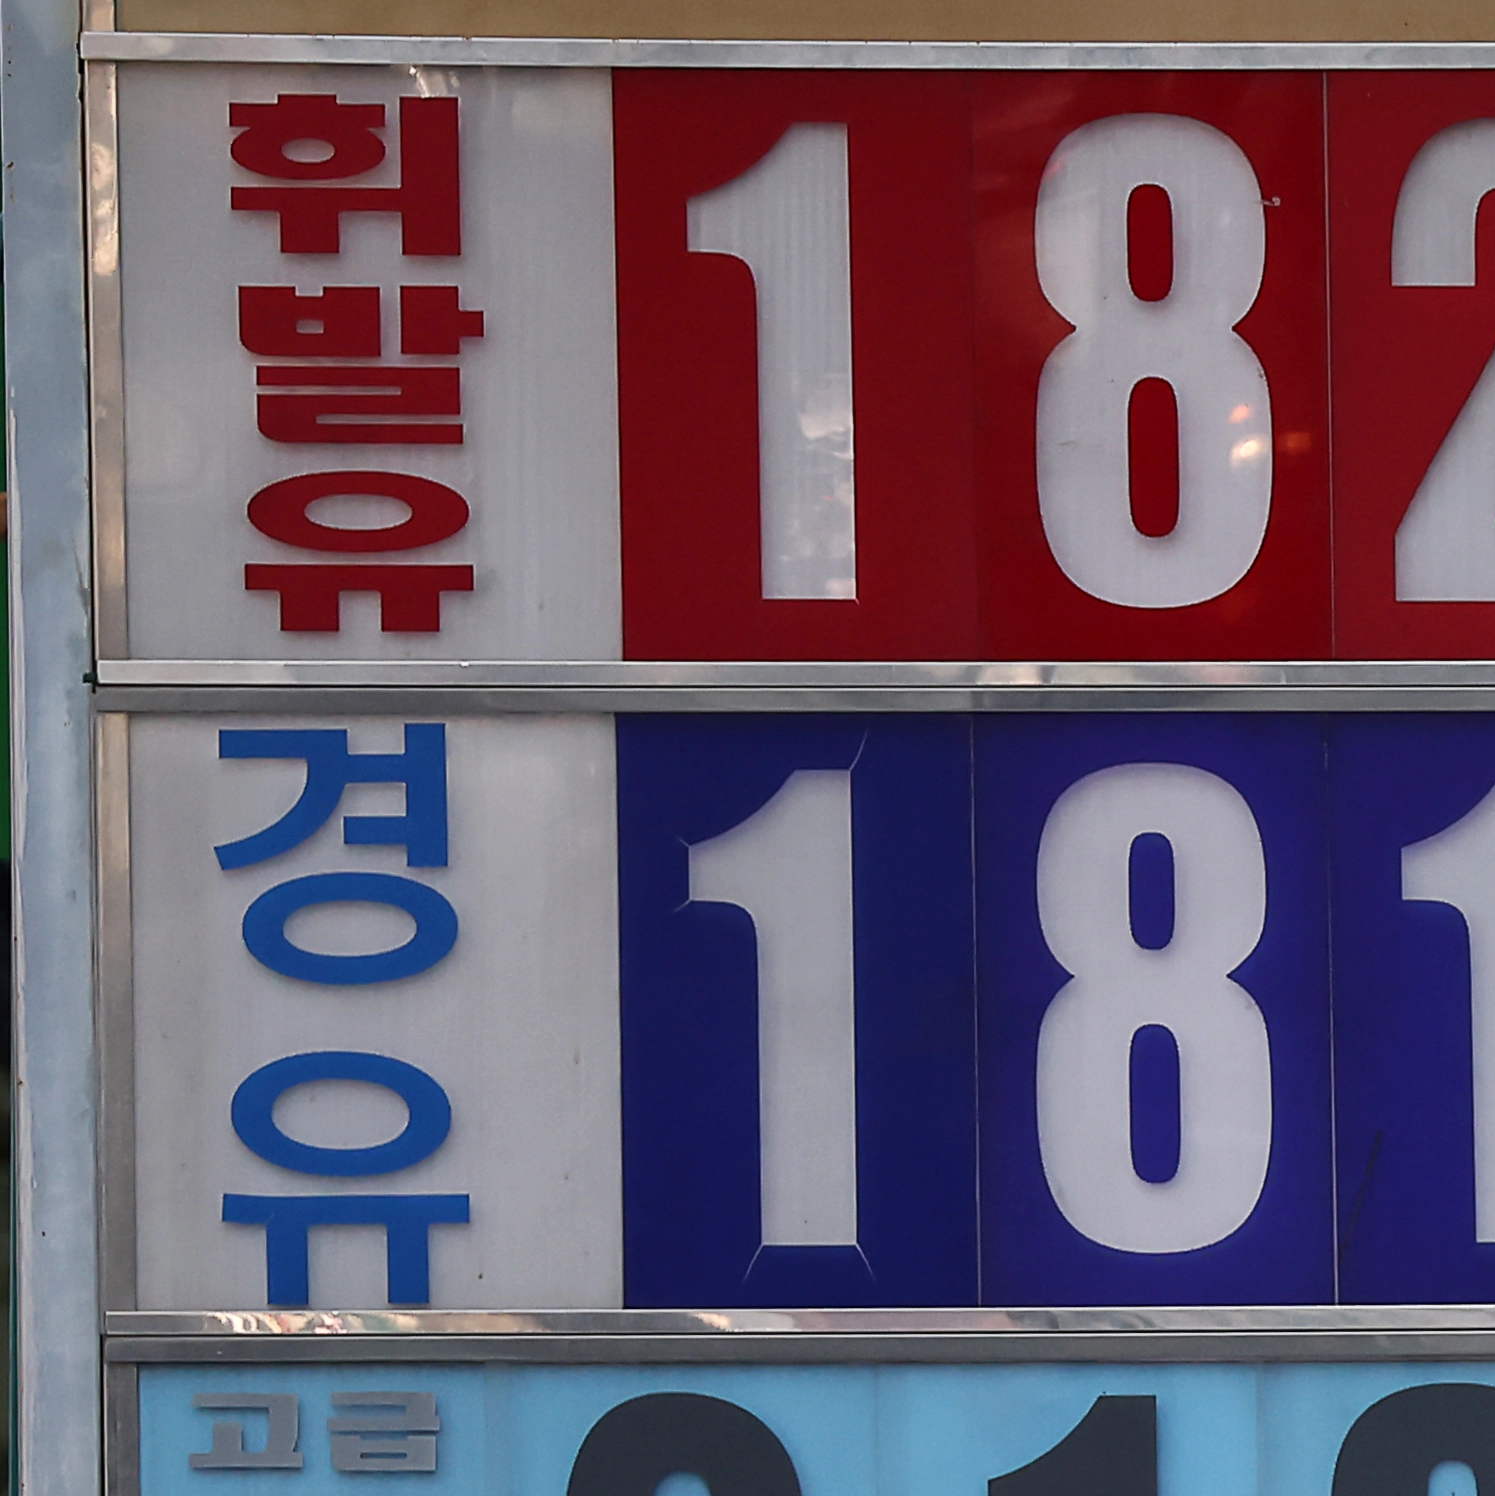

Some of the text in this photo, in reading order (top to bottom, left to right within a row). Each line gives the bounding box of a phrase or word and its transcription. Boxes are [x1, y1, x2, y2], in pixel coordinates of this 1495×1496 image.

[228, 93, 485, 632] 휘발유
[214, 723, 470, 1305] 경유
[189, 1391, 441, 1473] 고급
